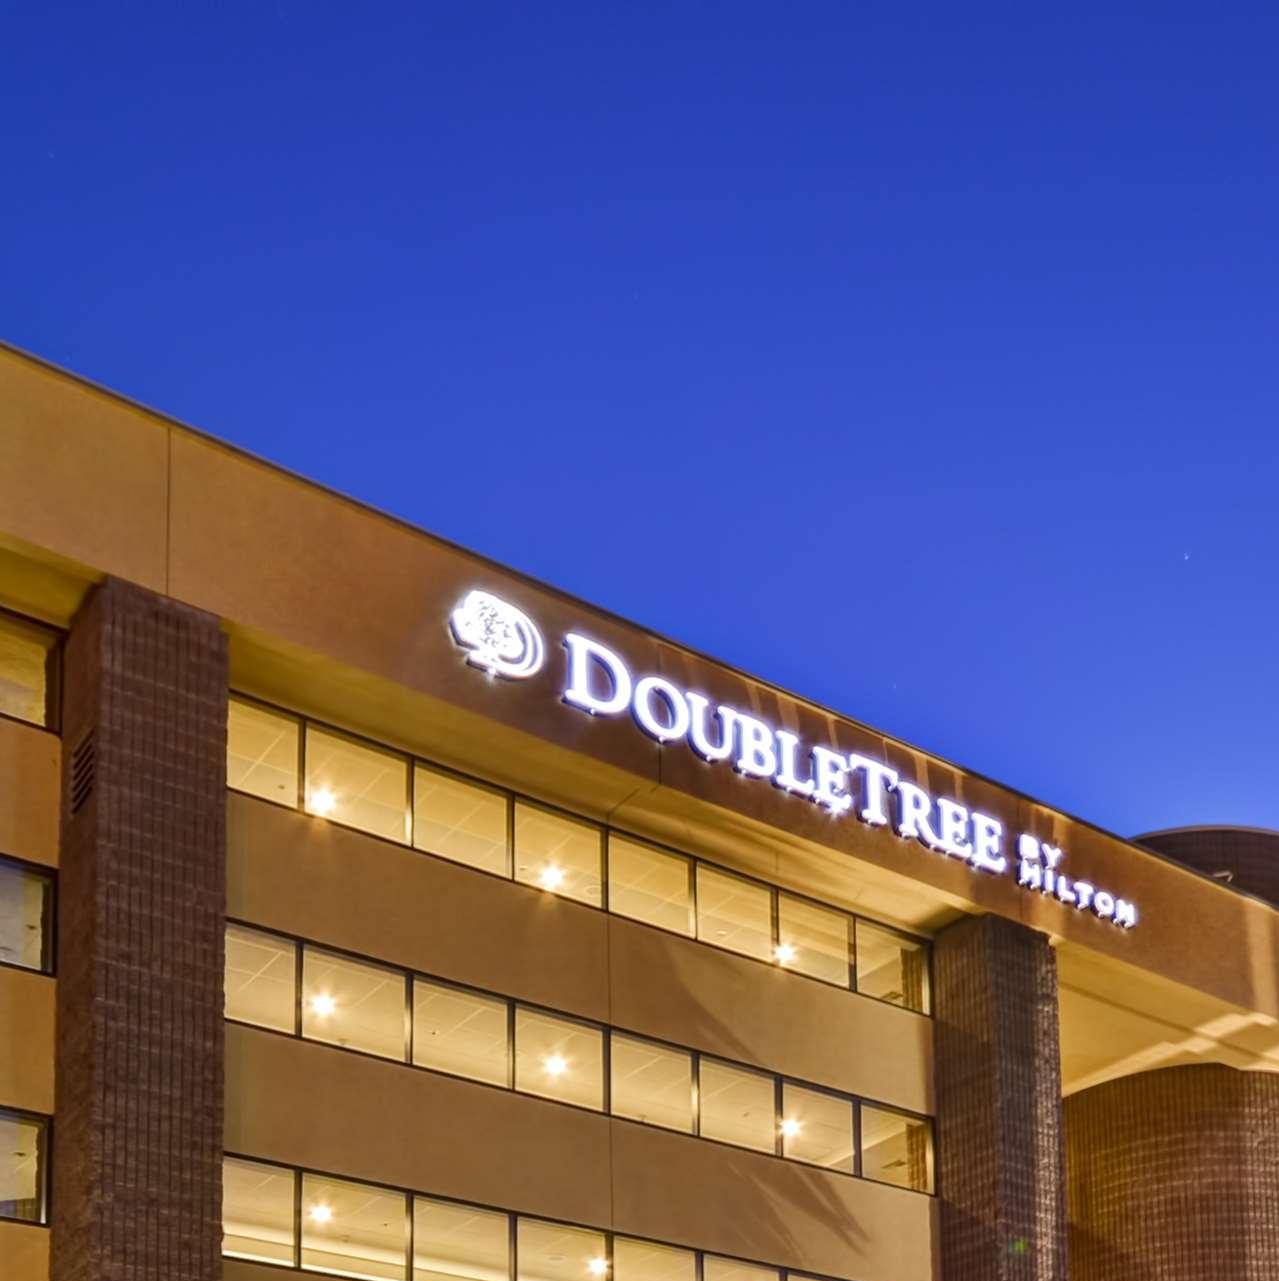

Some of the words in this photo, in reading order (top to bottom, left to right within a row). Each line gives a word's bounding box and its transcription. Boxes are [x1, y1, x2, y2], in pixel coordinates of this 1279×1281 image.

[564, 632, 1008, 873] DOUBLETREE
[1018, 834, 1062, 868] BY
[1019, 858, 1136, 928] HILTON
